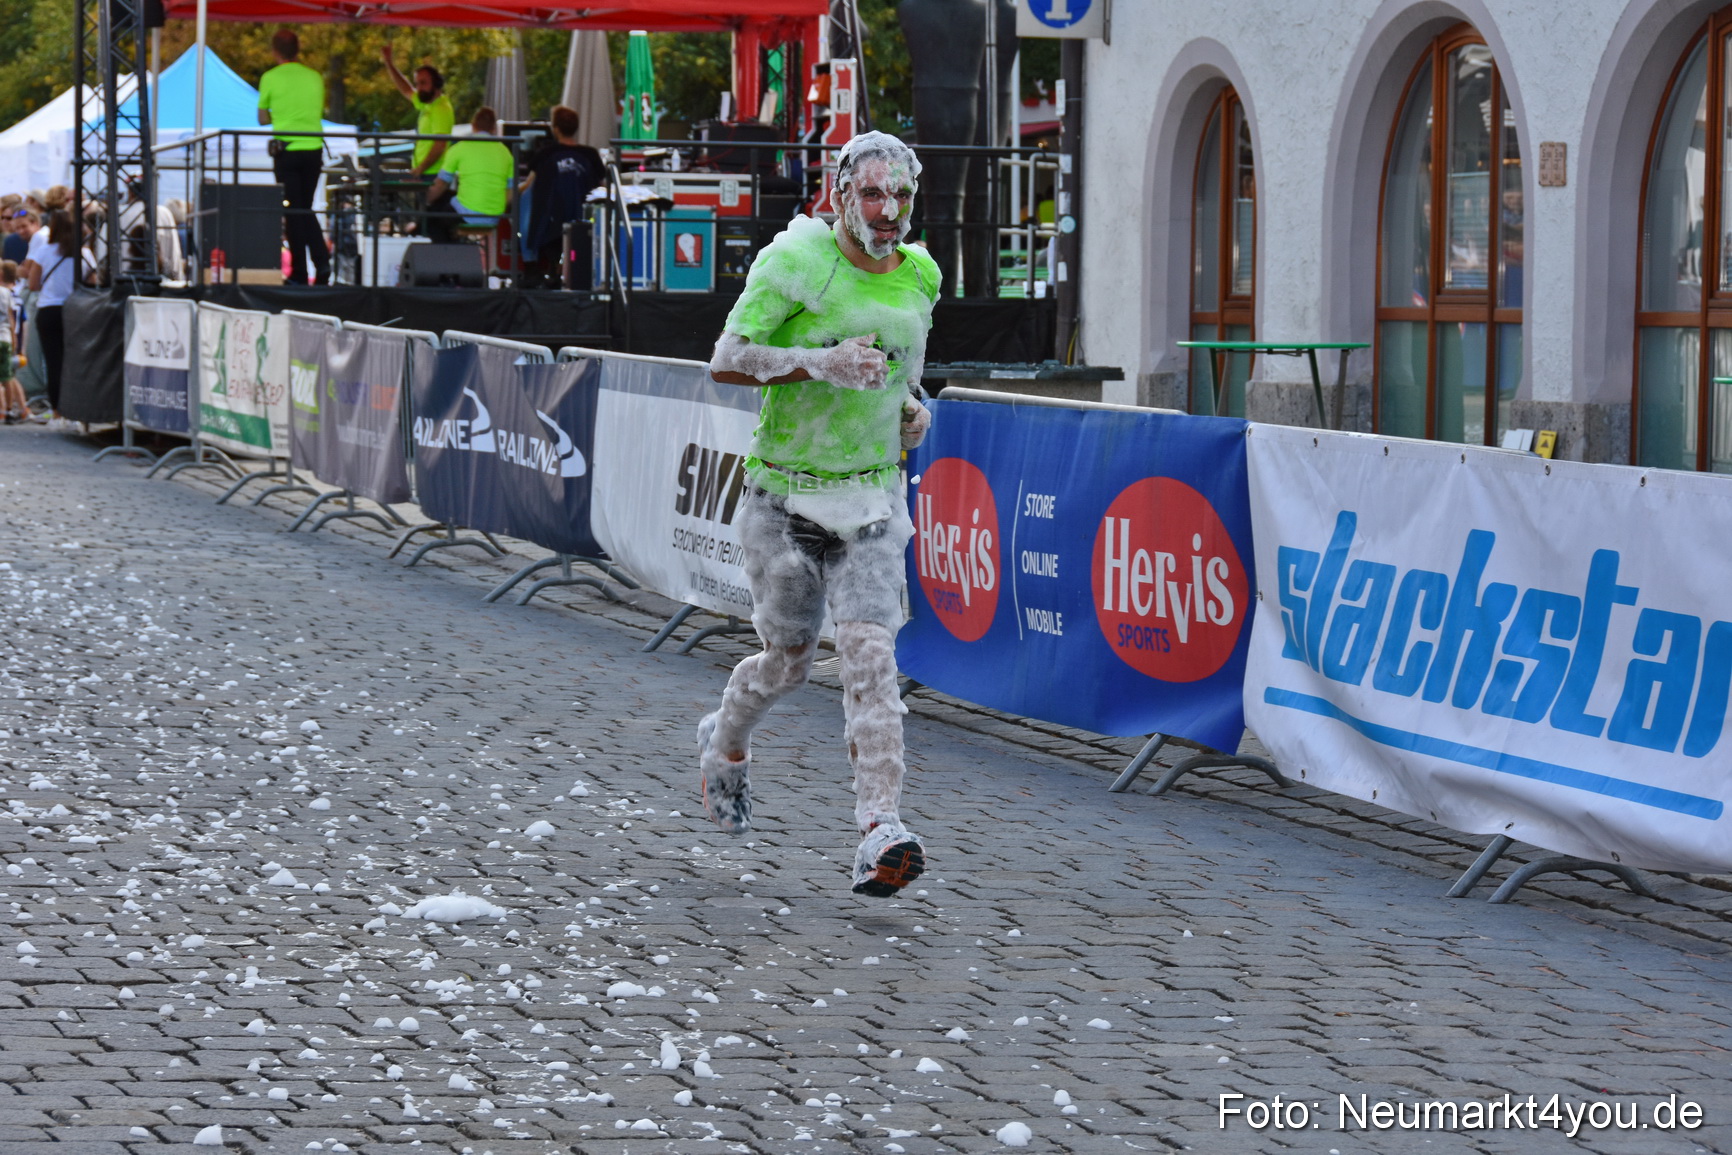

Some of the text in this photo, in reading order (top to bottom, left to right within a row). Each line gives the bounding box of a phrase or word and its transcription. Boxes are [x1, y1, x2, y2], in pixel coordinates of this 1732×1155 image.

[1024, 493, 1056, 519] STORE
[917, 492, 995, 607] Hervis
[1021, 550, 1059, 578] ONLINE
[1103, 516, 1235, 644] Hervis
[1025, 607, 1063, 636] MOBILE
[1117, 623, 1171, 653] SPORTS
